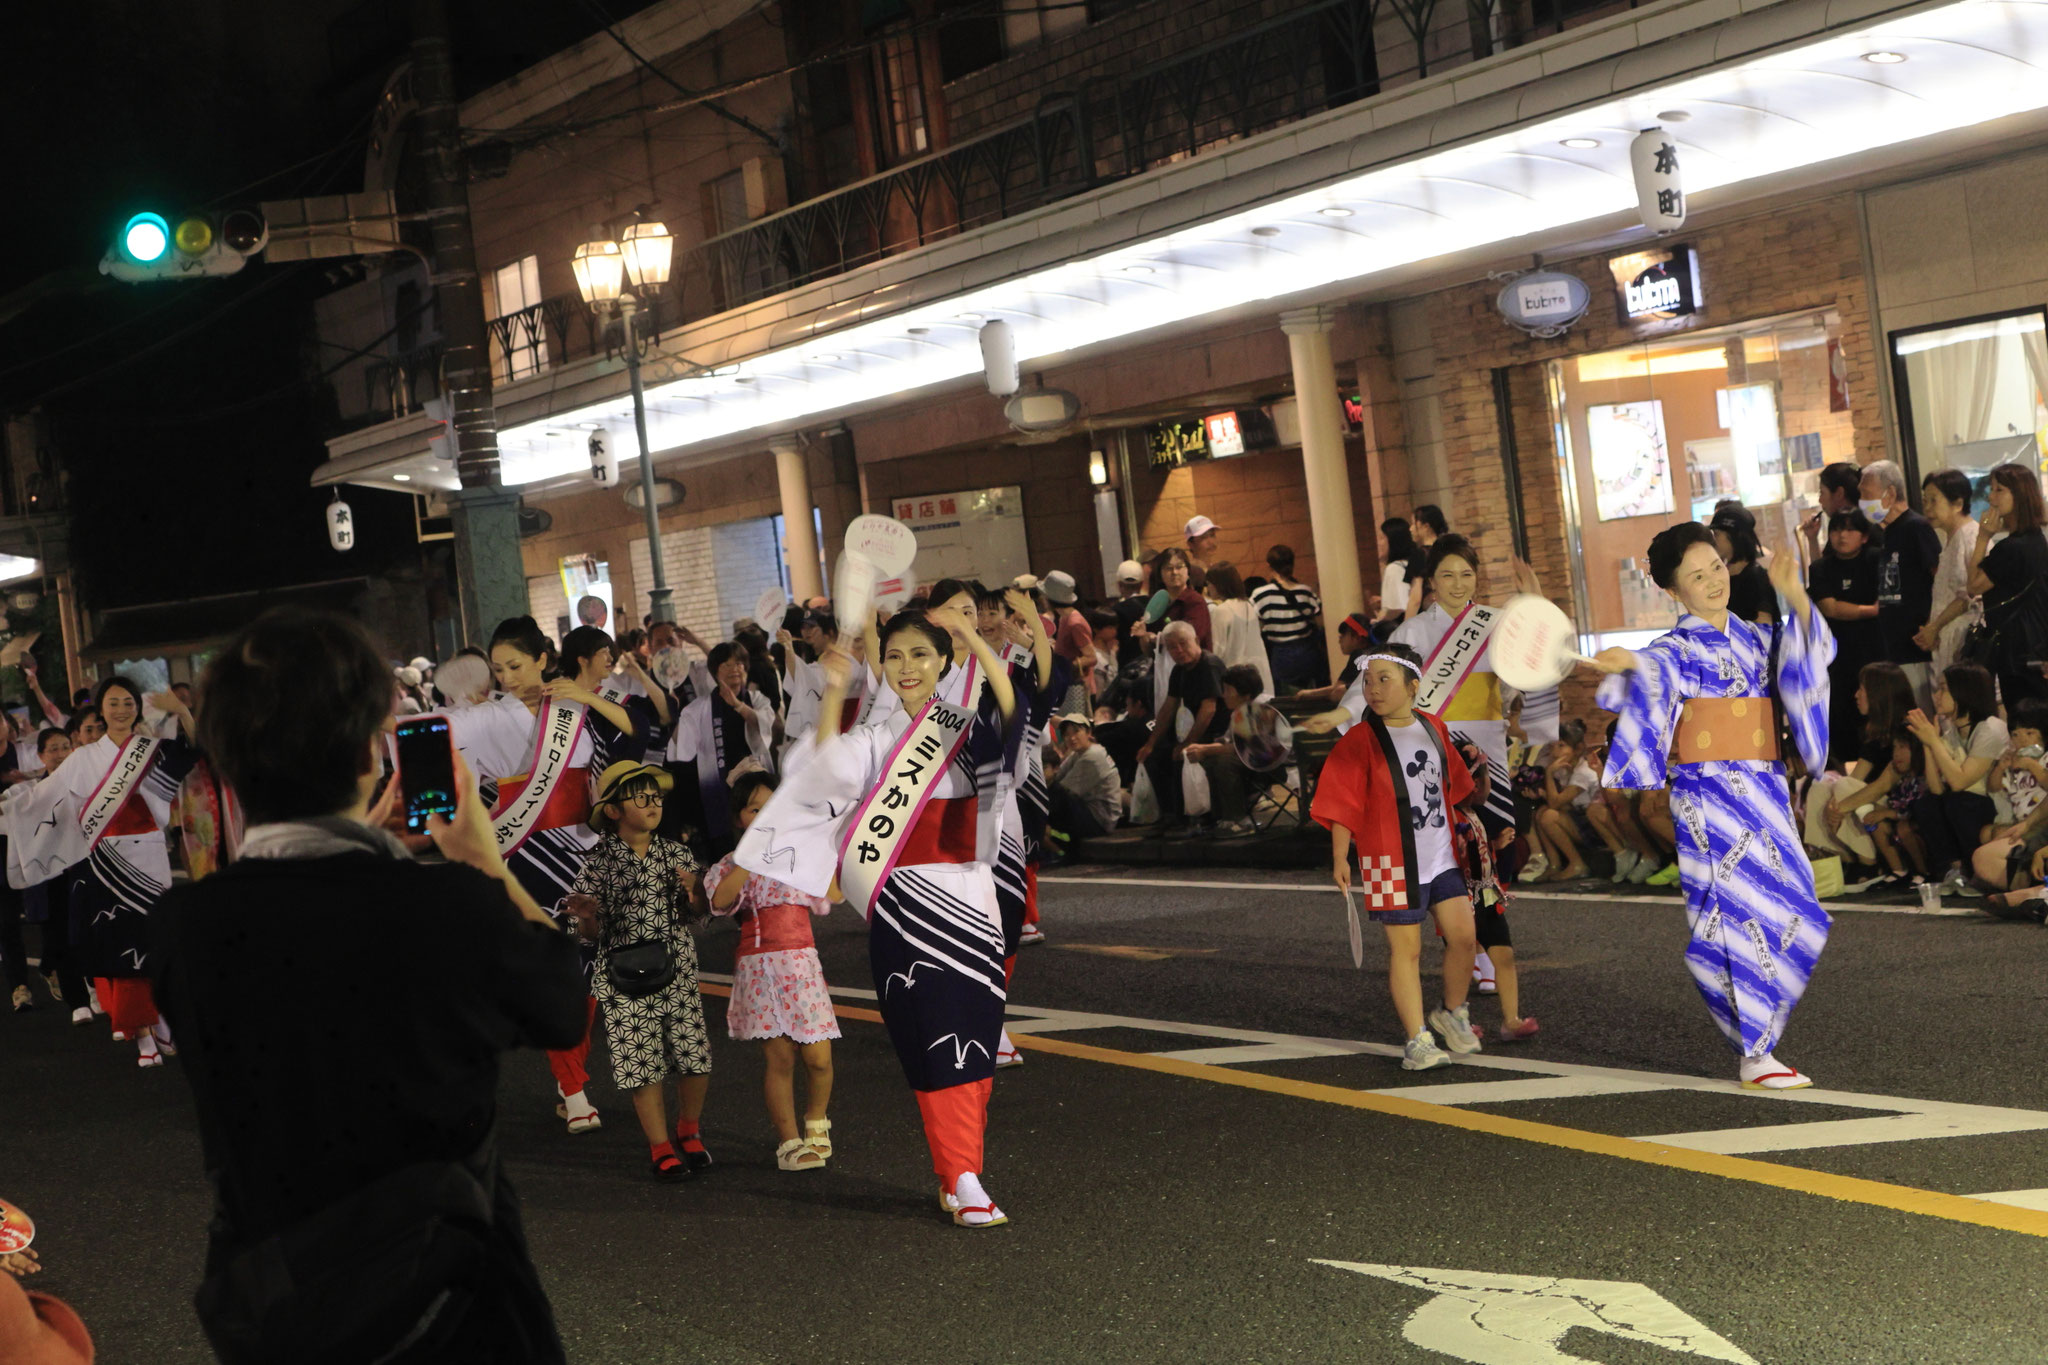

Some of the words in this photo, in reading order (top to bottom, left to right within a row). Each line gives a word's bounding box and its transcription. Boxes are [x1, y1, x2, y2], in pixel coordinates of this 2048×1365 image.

[1653, 142, 1682, 217] 本町
[589, 438, 606, 480] 本町
[336, 509, 350, 545] 本町
[897, 499, 957, 519] 貸店舗
[927, 705, 967, 733] 2004
[857, 735, 942, 864] ミスかのや
